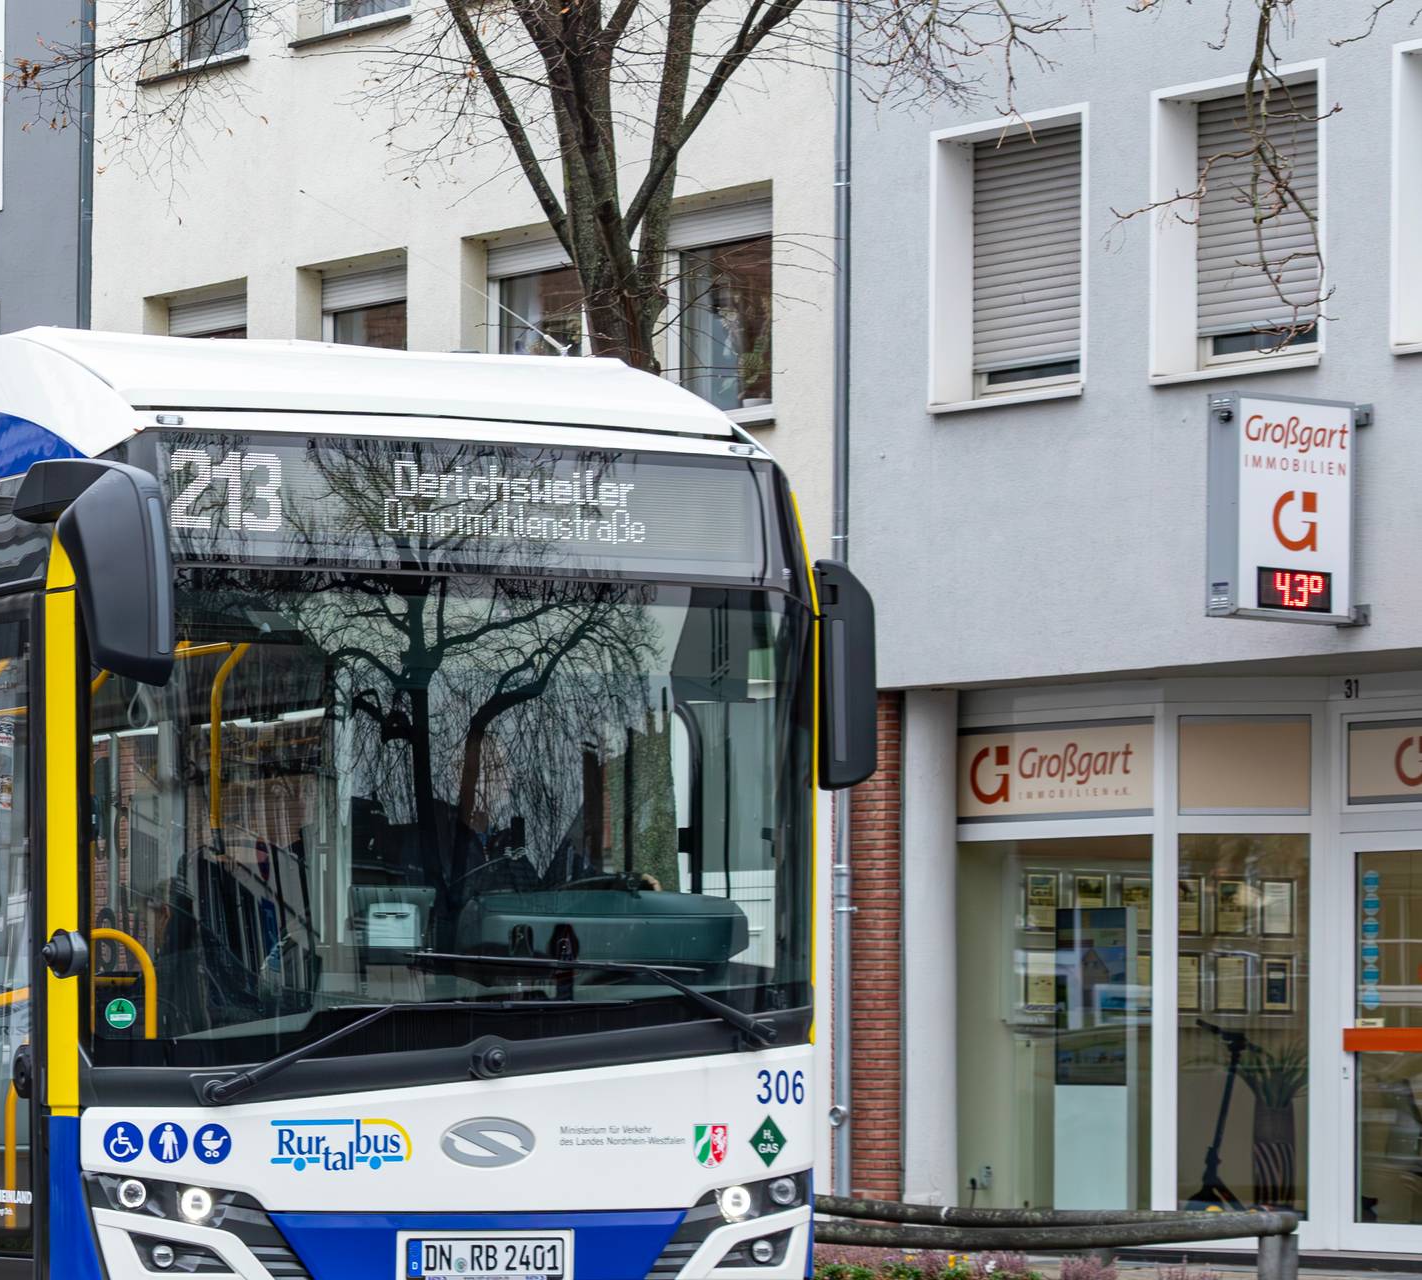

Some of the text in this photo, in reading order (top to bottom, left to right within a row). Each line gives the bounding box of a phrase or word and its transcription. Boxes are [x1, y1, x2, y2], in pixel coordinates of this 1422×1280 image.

[1245, 414, 1349, 453] Großgart
[1245, 454, 1347, 476] IMMOBILIEN
[170, 449, 282, 531] 213
[394, 460, 635, 508] Derichsweiler
[1344, 678, 1359, 699] 31
[1018, 742, 1133, 785] Großgart
[1018, 787, 1109, 800] IMMOBILIEN
[116, 1001, 125, 1013] 4
[756, 1069, 805, 1105] 306
[559, 1136, 686, 1146] des Landes Nordrhein-Westfalen
[560, 1125, 652, 1135] Ministerium für Verkehr
[758, 1143, 779, 1154] GAS
[411, 1244, 559, 1271] D DN RB 2401
